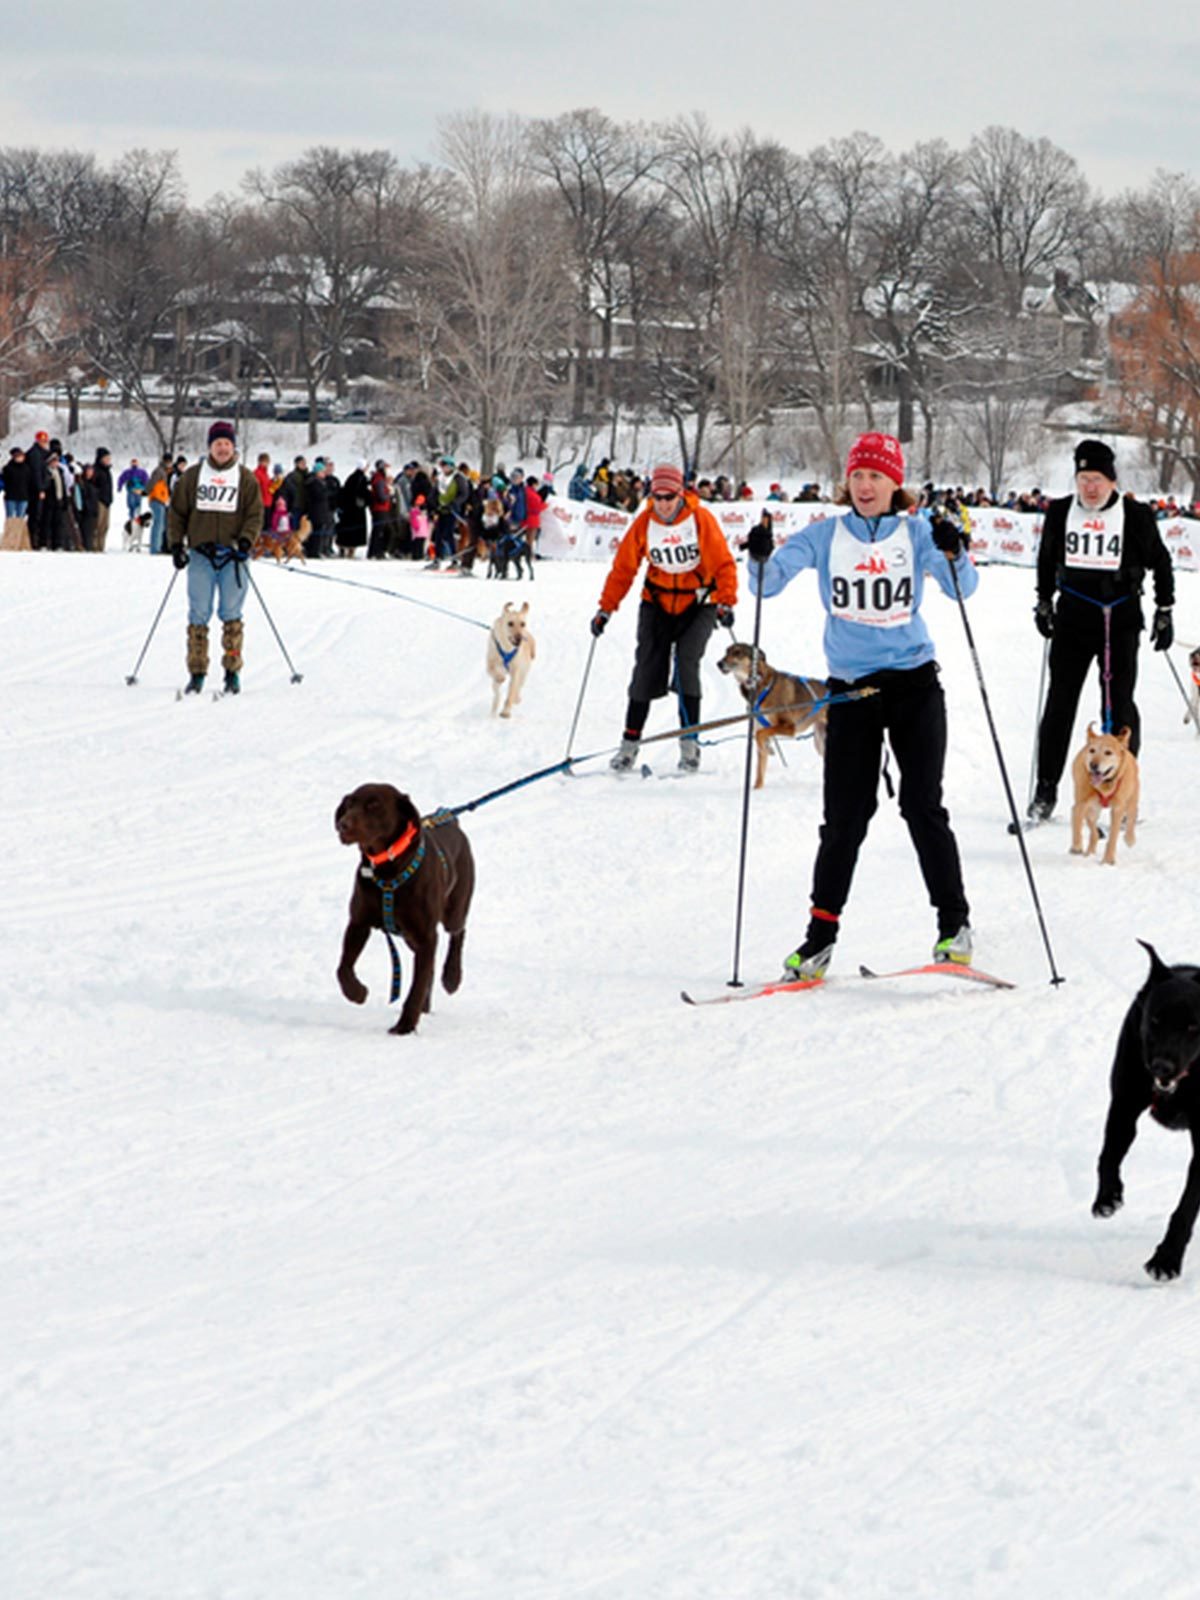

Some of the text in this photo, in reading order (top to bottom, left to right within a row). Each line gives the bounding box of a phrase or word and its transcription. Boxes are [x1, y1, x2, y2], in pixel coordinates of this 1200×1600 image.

[196, 484, 238, 502] 9077
[650, 543, 700, 565] 9105
[1066, 531, 1122, 557] 9114
[892, 547, 907, 568] 3
[832, 576, 915, 611] 9104
